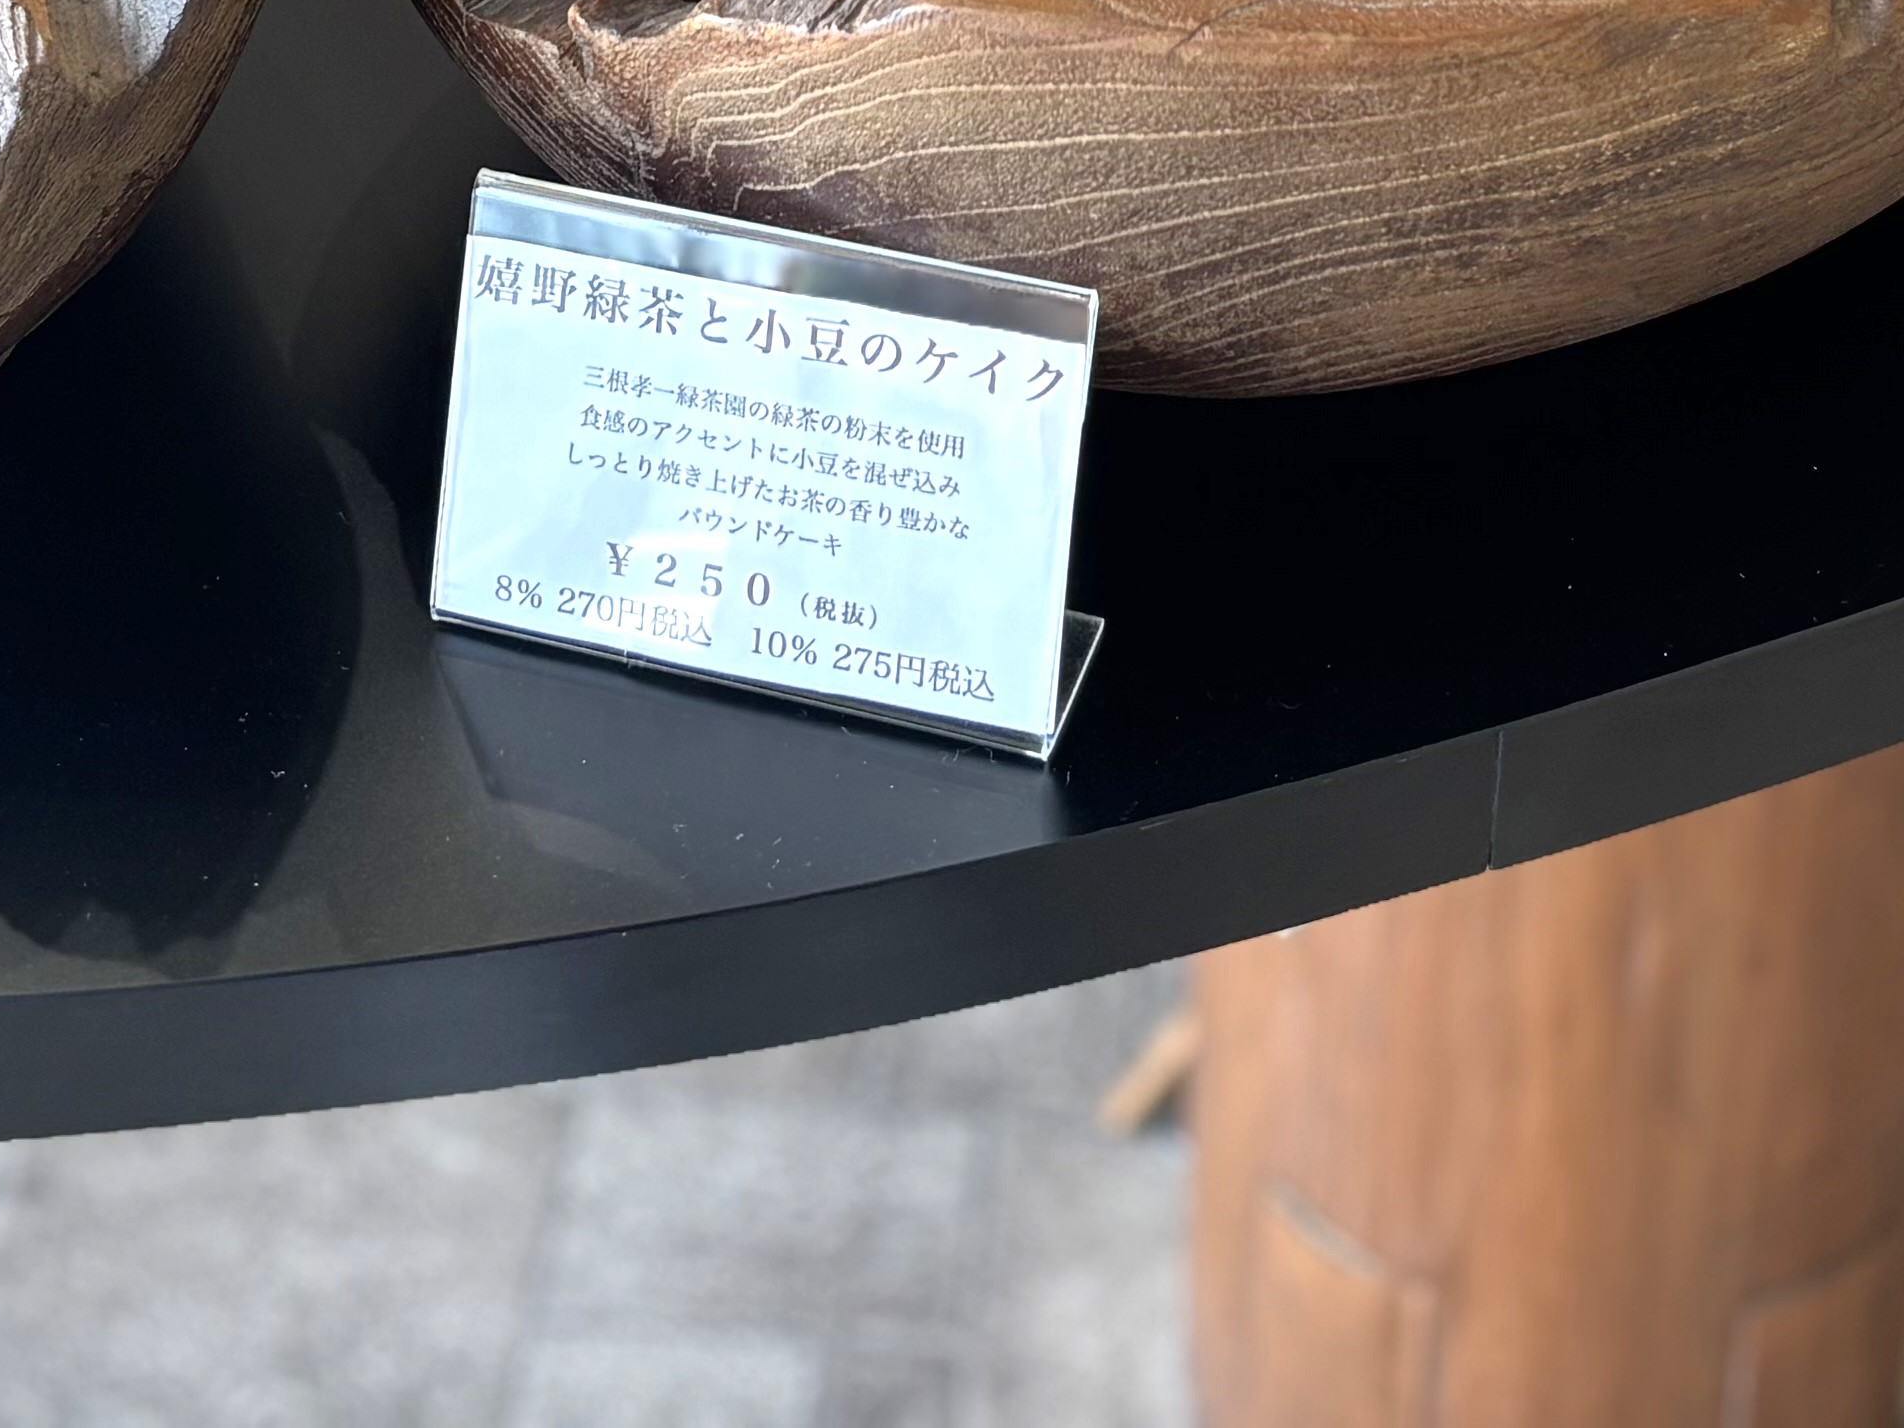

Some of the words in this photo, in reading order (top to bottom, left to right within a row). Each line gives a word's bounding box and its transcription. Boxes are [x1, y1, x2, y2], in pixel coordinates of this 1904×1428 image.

[475, 254, 1064, 401] 嬉野緑茶と小豆のケイク
[580, 403, 960, 498] 食感のアクセントに小豆を混ぜ込み
[583, 365, 964, 460] 三根孝一緑茶園の緑茶の粉末を使用
[568, 442, 969, 540] しっとり焼き上げたお茶の香り豊かな
[678, 507, 842, 557] パウンドケーキ
[605, 542, 770, 607] ¥250
[494, 574, 542, 609] 8%
[556, 586, 712, 648] 270円税込
[751, 627, 817, 665] 10%
[832, 643, 994, 702] 275円税込
